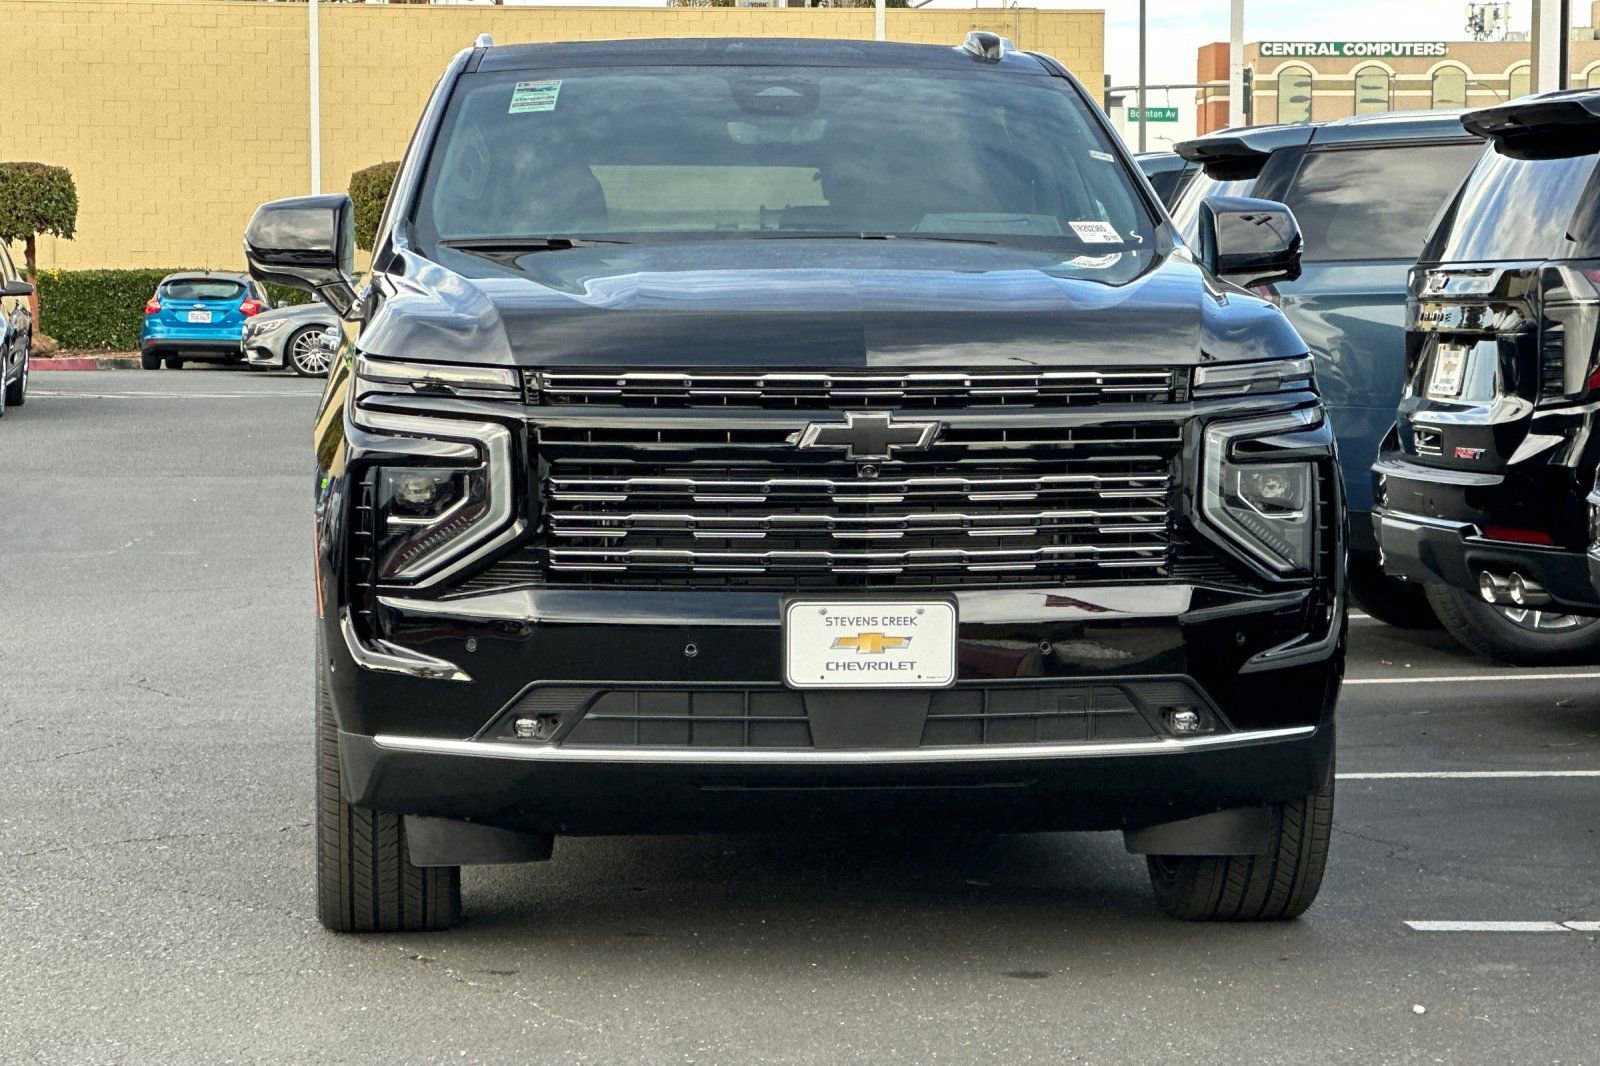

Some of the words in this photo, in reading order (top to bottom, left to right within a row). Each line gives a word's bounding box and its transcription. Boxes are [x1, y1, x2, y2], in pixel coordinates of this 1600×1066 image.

[1260, 43, 1340, 56] CENTRAL
[1343, 43, 1446, 56] COMPUTERS
[1130, 110, 1163, 118] Bonton
[1166, 110, 1176, 118] Av
[825, 616, 878, 627] STEVENS
[882, 616, 917, 626] CREEK
[825, 661, 917, 671] CHEVROLET
